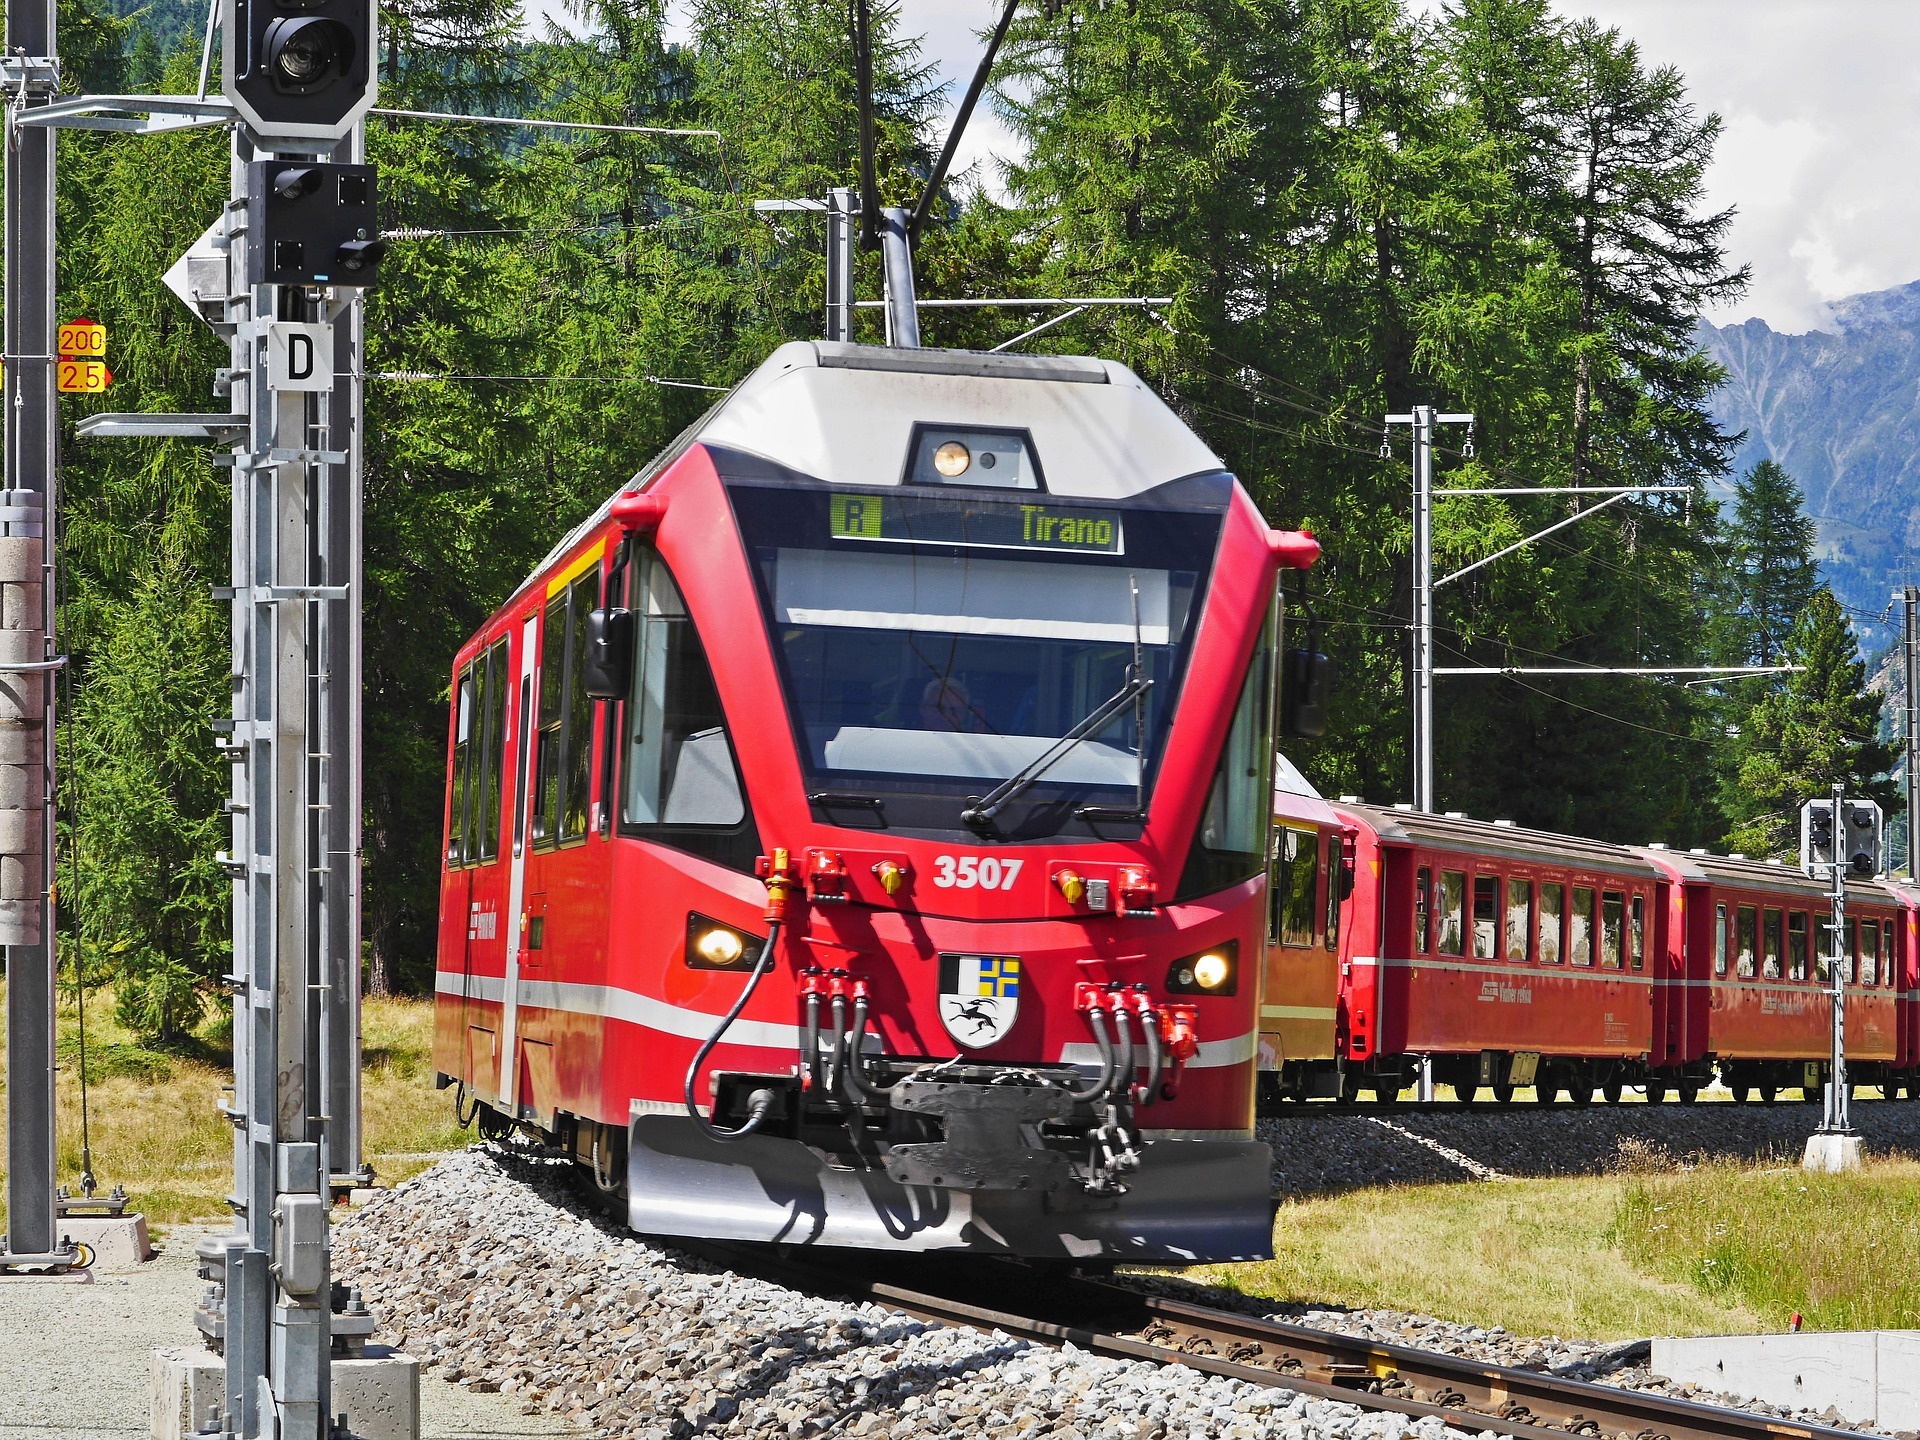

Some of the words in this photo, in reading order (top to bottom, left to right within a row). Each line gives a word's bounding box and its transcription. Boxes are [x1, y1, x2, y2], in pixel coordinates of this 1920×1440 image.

[61, 330, 103, 351] 200
[288, 333, 314, 380] D
[62, 365, 100, 389] 2.5
[1019, 504, 1112, 545] Tirano
[932, 854, 1025, 891] 3507
